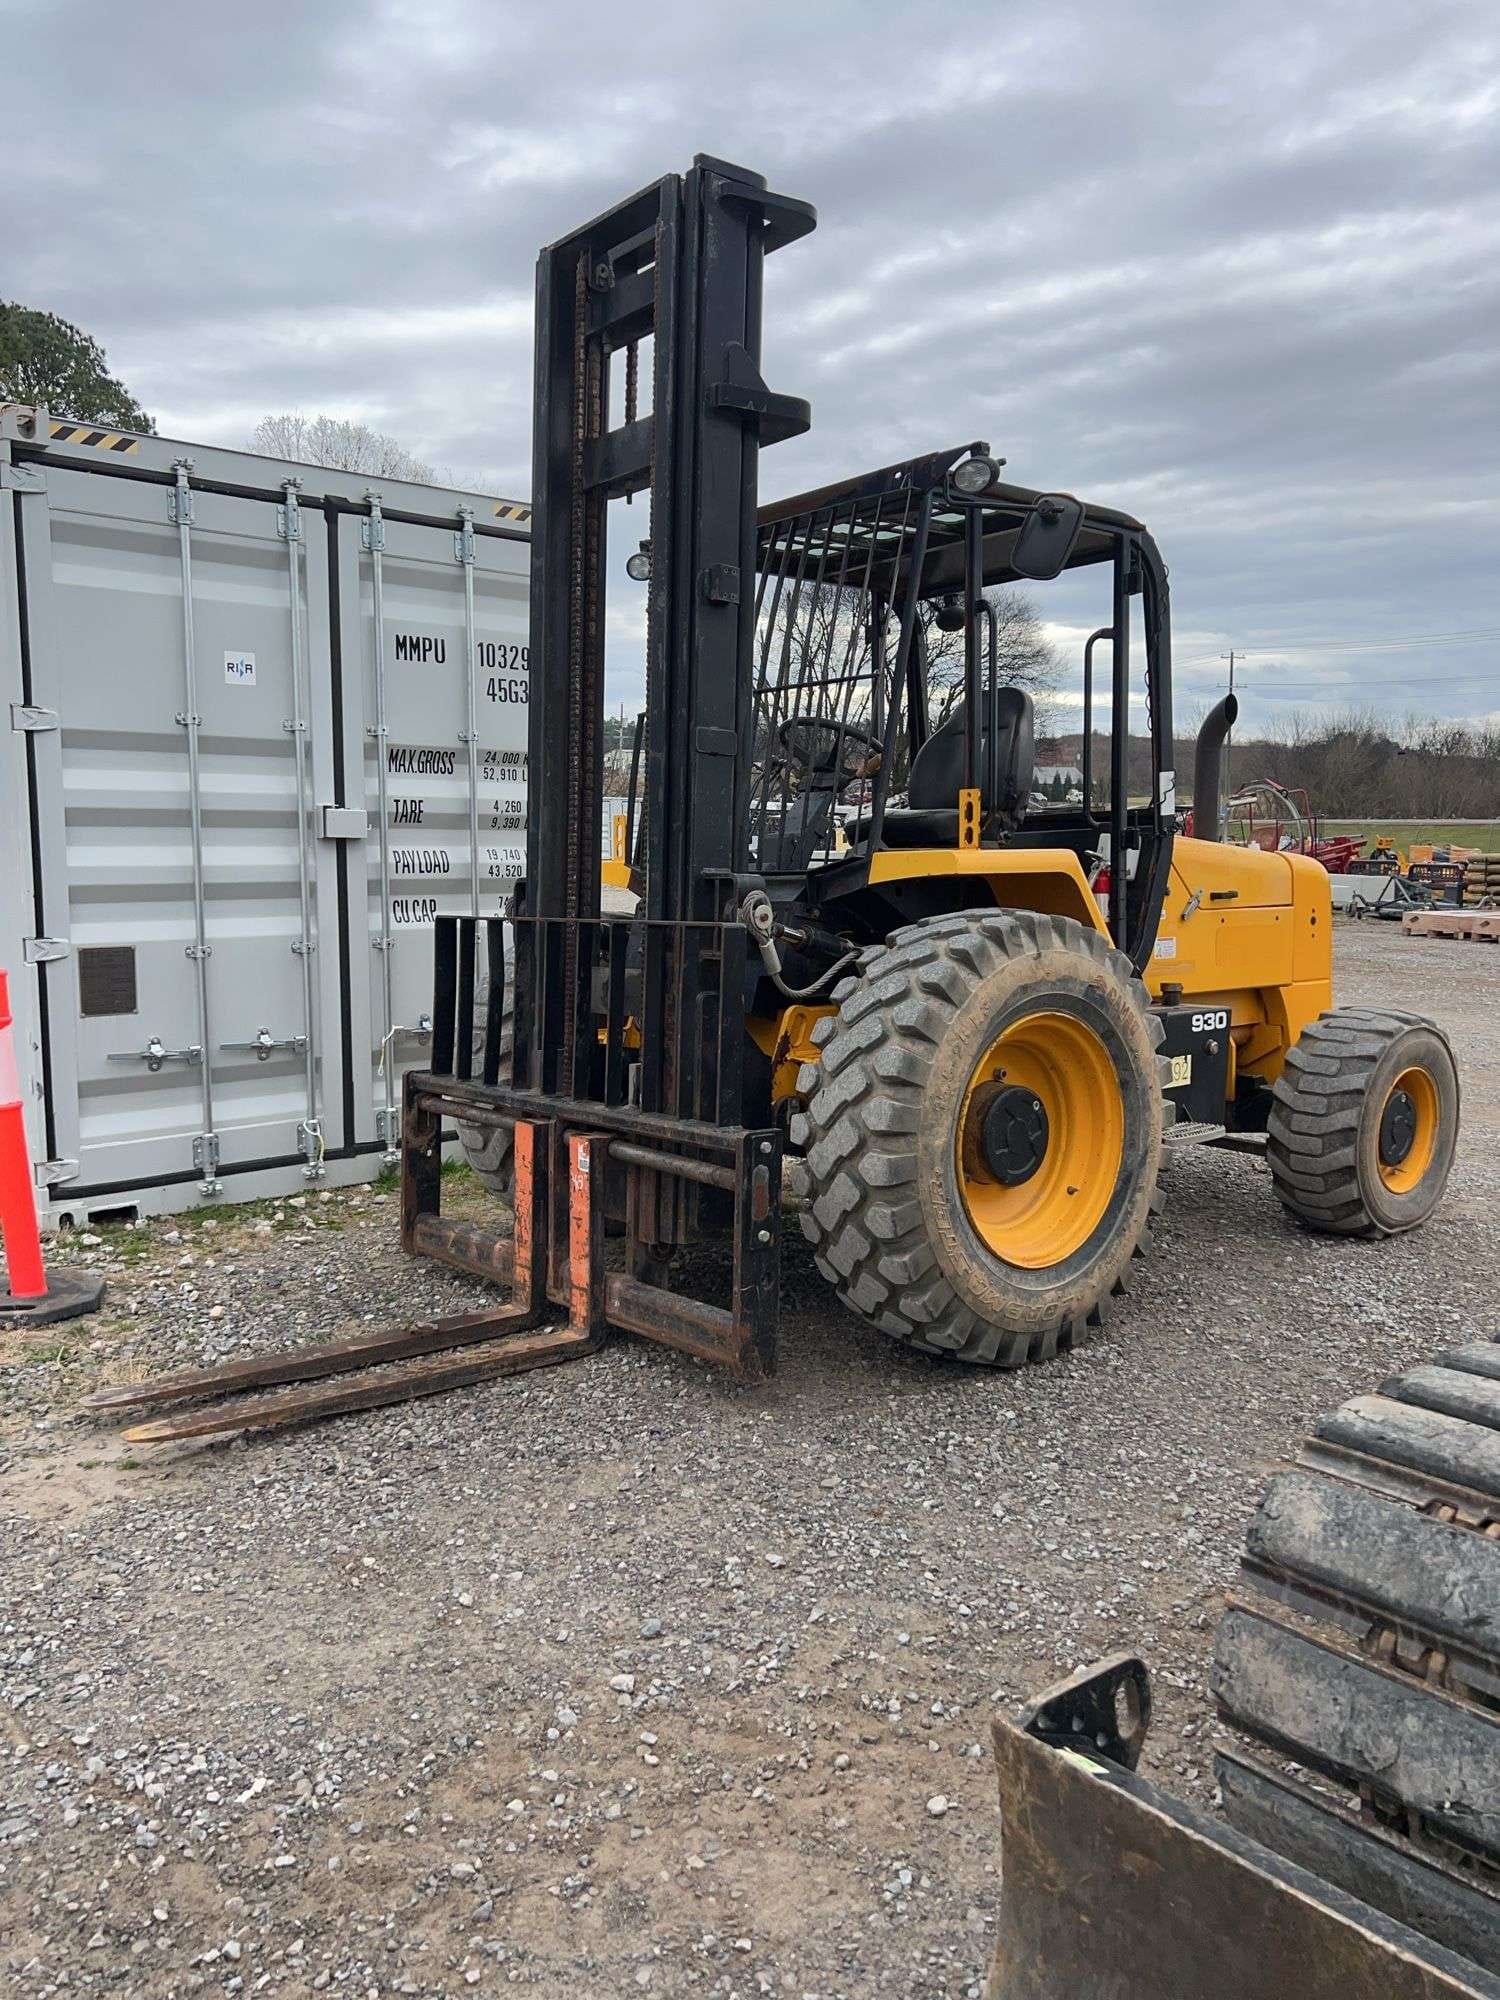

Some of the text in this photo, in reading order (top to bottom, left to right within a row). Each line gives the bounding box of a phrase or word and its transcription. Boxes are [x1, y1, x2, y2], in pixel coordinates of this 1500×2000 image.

[395, 634, 530, 671] MMPU 10329
[486, 677, 529, 704] 45G3
[388, 748, 456, 775] MAX.GROSS
[484, 751, 520, 765] 24,000
[483, 767, 518, 783] 52,910
[393, 799, 522, 824] TARE 4,260
[491, 816, 520, 830] 9,390
[393, 849, 450, 874] PAYLOAD
[486, 848, 521, 862] 19,740
[488, 864, 522, 878] 43,520
[393, 898, 437, 923] CU.CAP
[1191, 1011, 1228, 1032] 930
